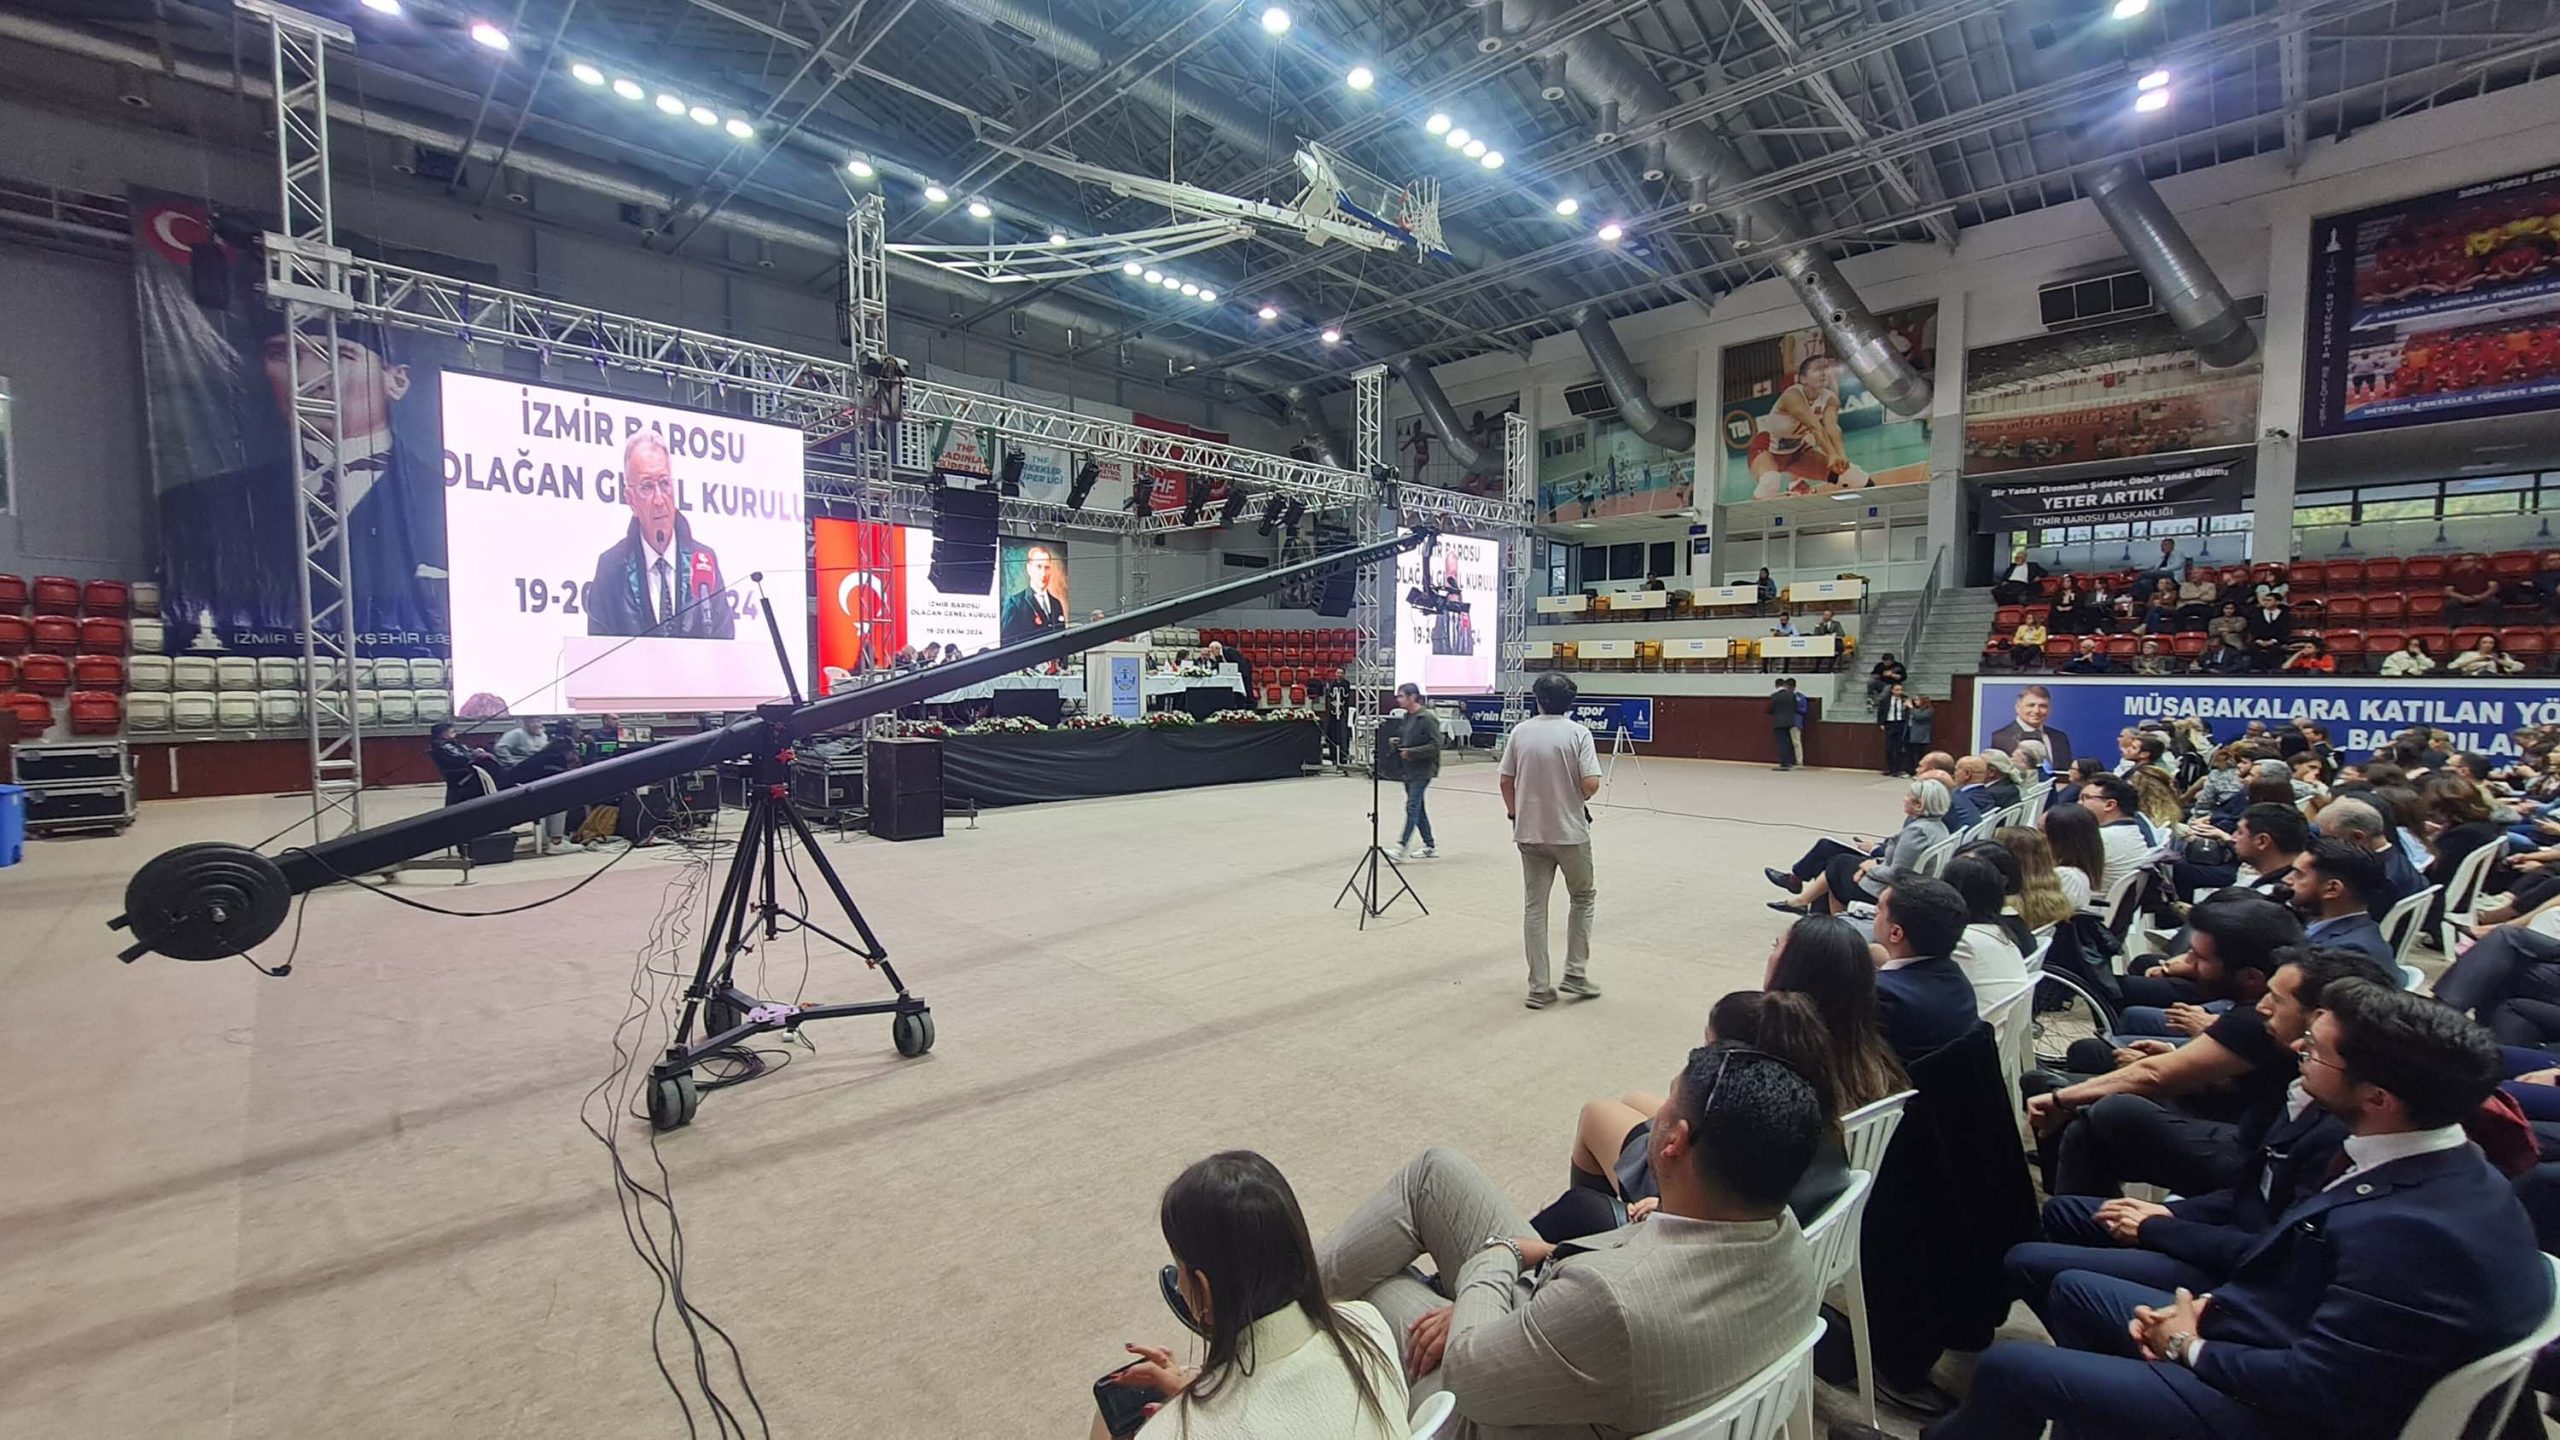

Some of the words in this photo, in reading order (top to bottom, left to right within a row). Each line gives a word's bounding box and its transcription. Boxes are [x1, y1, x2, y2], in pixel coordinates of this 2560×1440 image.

[522, 387, 614, 446] İZMİR
[943, 451, 983, 464] ADINLA
[1097, 461, 1122, 472] RKİYE
[443, 448, 584, 500] OLAĞAN
[595, 469, 693, 511] GEL
[1023, 463, 1062, 475] RKEKLER
[1152, 477, 1177, 494] HF
[1991, 488, 2006, 497] Bir
[2007, 487, 2038, 496] Yanda
[2039, 482, 2089, 493] Ekonomik
[2157, 471, 2192, 482] Yanda
[2042, 494, 2098, 510] YETER
[2101, 487, 2165, 505] ARTIK!
[2032, 515, 2062, 526] İZMİR
[2063, 513, 2105, 524] BAROSU
[2107, 506, 2174, 521] BAŞKANLIĞI
[1577, 706, 1606, 717] spor
[2123, 692, 2351, 721] MÜSABAKALARA
[2360, 699, 2504, 725] KATILAN
[2347, 728, 2524, 757] BAILA
